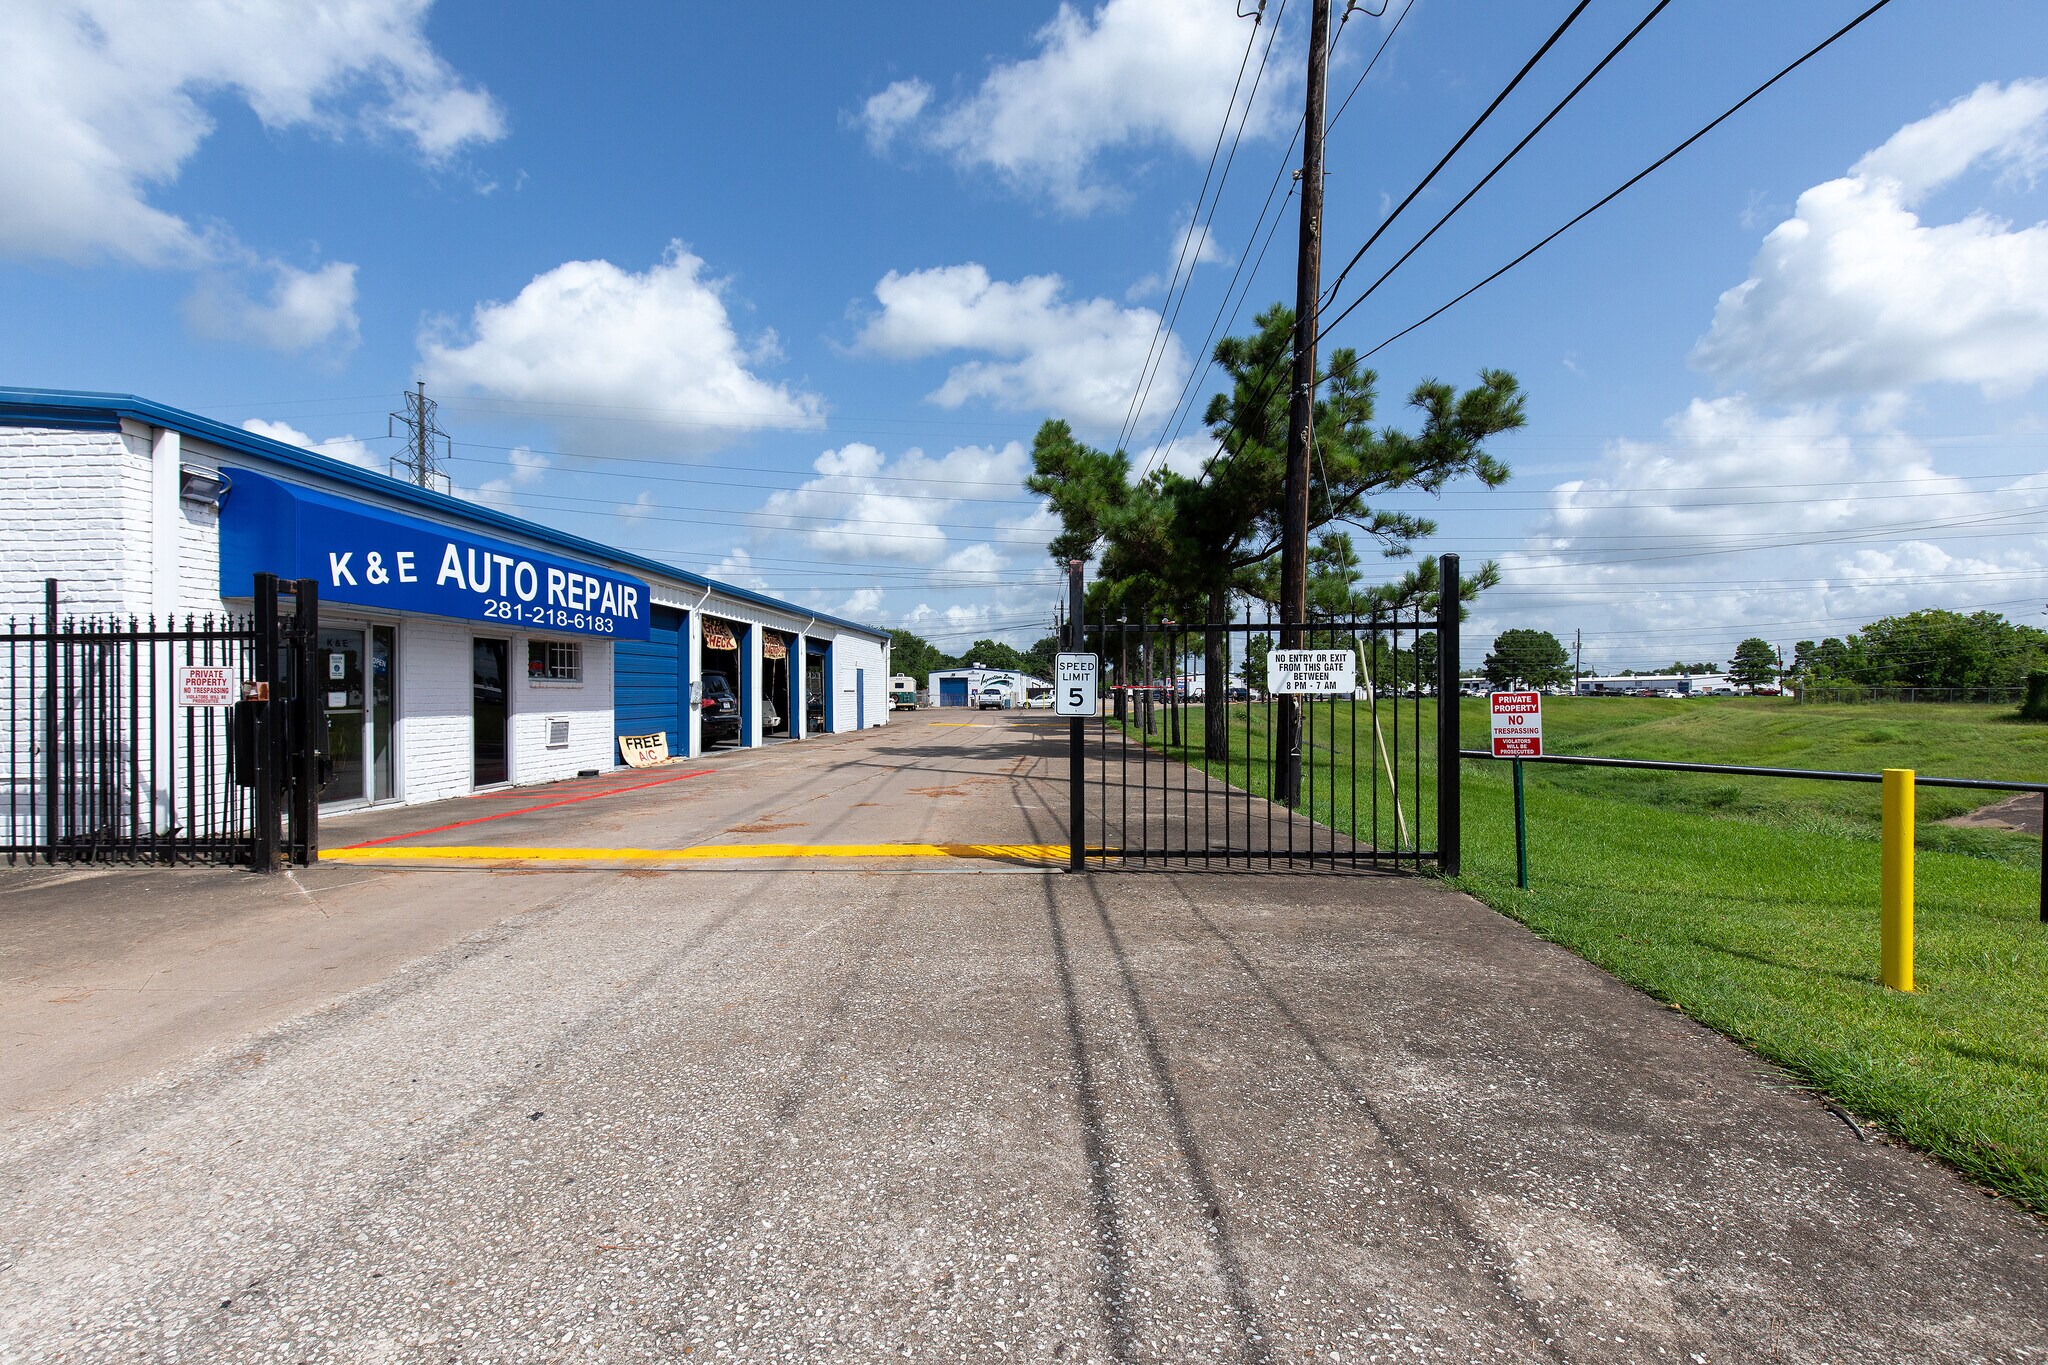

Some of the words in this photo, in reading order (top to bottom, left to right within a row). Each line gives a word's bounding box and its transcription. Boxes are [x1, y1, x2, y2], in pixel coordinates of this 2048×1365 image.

[329, 552, 358, 587] K
[366, 551, 390, 585] &
[396, 551, 418, 583] E
[436, 543, 539, 602] AUTO
[547, 567, 639, 620] REPAIR
[483, 599, 614, 633] 281-218-6183
[326, 639, 333, 647] K
[1275, 654, 1286, 662] NO
[1289, 654, 1313, 662] ENTRY
[1316, 654, 1327, 662] OR
[1330, 654, 1347, 662] EXIT
[1059, 662, 1095, 671] SPEED
[1279, 663, 1301, 671] FROM
[1304, 663, 1321, 671] THIS
[1324, 663, 1344, 671] GATE
[190, 670, 223, 678] PRIVATE
[1062, 673, 1091, 681] LIMIT
[1293, 672, 1329, 680] BETWEEN
[185, 678, 227, 686] PROPERTY
[1286, 681, 1292, 690] 8
[1294, 681, 1307, 690] PM
[1316, 681, 1321, 690] 7
[1324, 681, 1337, 690] AM
[1069, 687, 1084, 707] 5
[1494, 704, 1537, 712] PROPERTY
[1508, 715, 1524, 725] NO
[626, 734, 663, 750] FREE
[639, 749, 657, 761] A/C
